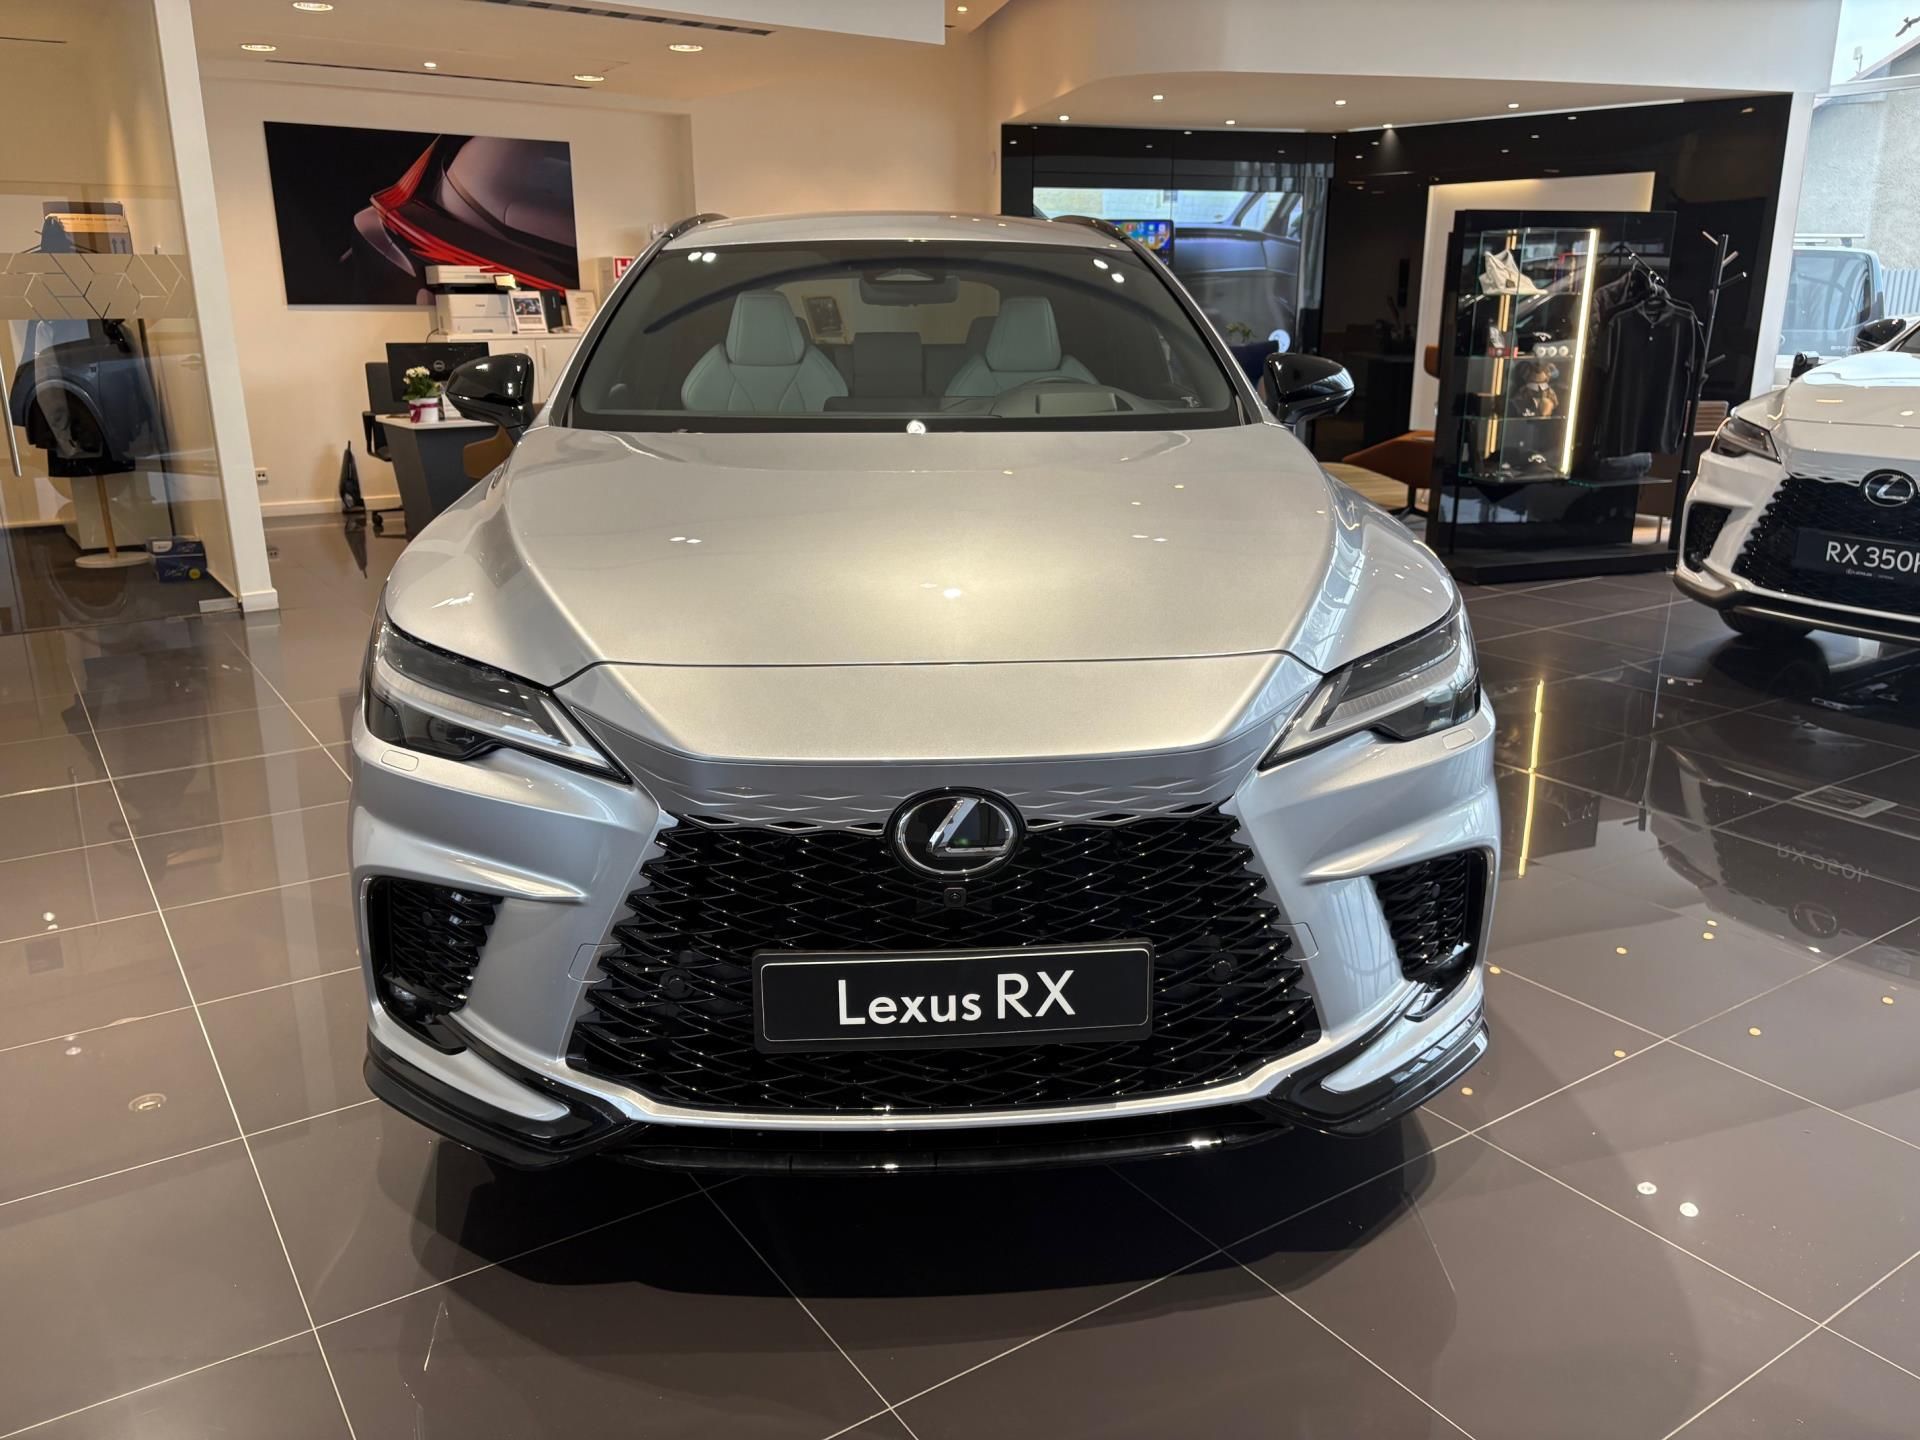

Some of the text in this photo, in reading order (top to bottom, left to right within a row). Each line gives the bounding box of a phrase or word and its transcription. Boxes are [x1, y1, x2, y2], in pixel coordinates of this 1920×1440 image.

[1826, 541, 1860, 565] RX
[838, 969, 1076, 1025] Lexus RX
